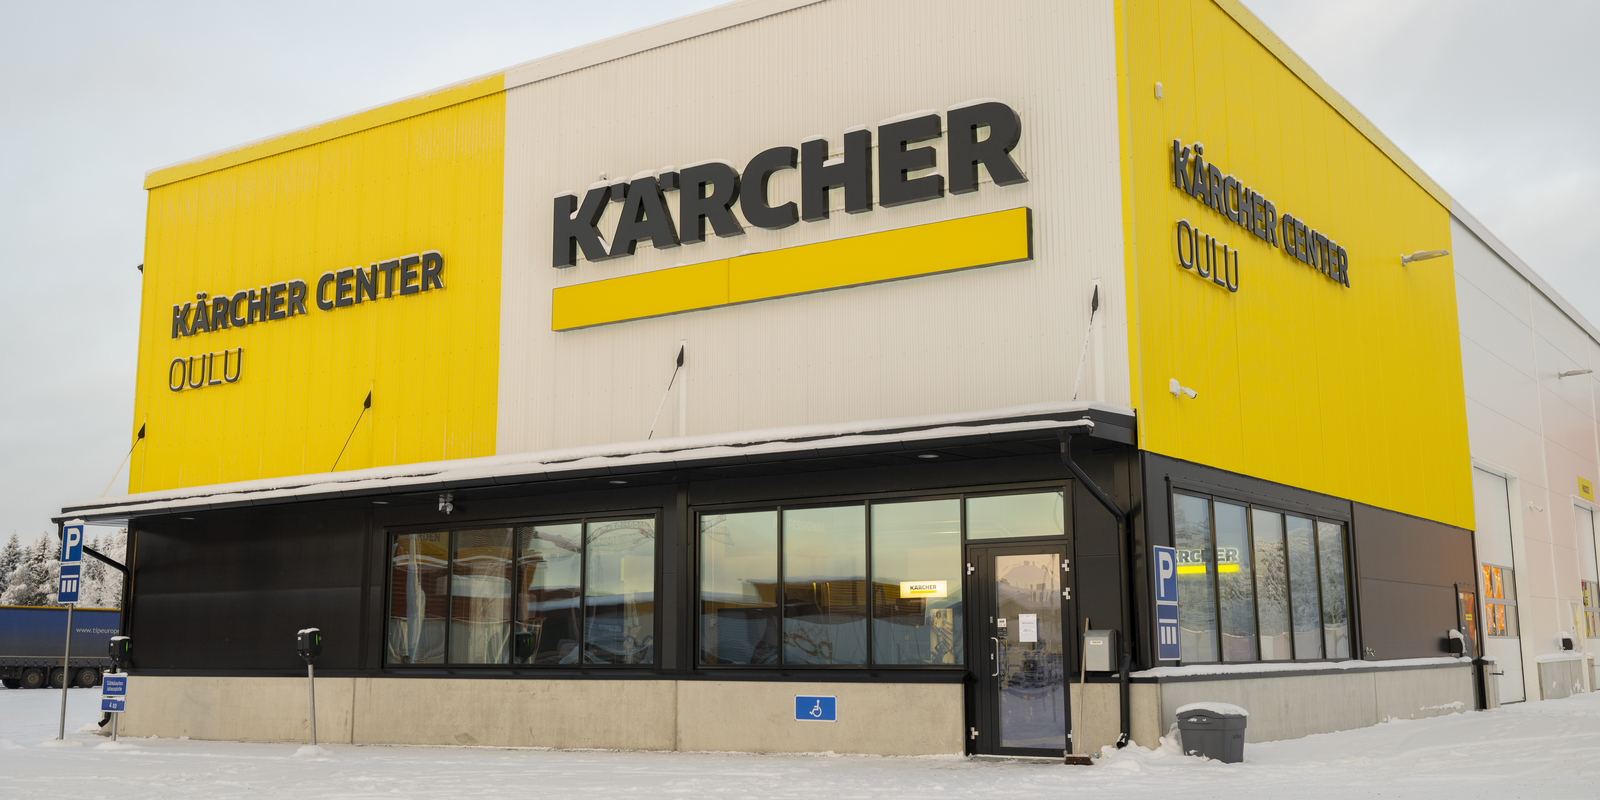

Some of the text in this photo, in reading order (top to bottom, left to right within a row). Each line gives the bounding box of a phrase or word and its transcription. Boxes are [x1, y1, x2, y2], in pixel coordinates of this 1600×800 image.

[552, 100, 1028, 269] KÄRCHER
[1173, 139, 1350, 288] KÄRCHER CENTER
[1177, 220, 1238, 292] OULU
[171, 251, 443, 339] KÄRCHER CENTER
[169, 347, 242, 392] OULU
[65, 527, 80, 559] P
[1158, 551, 1174, 598] P
